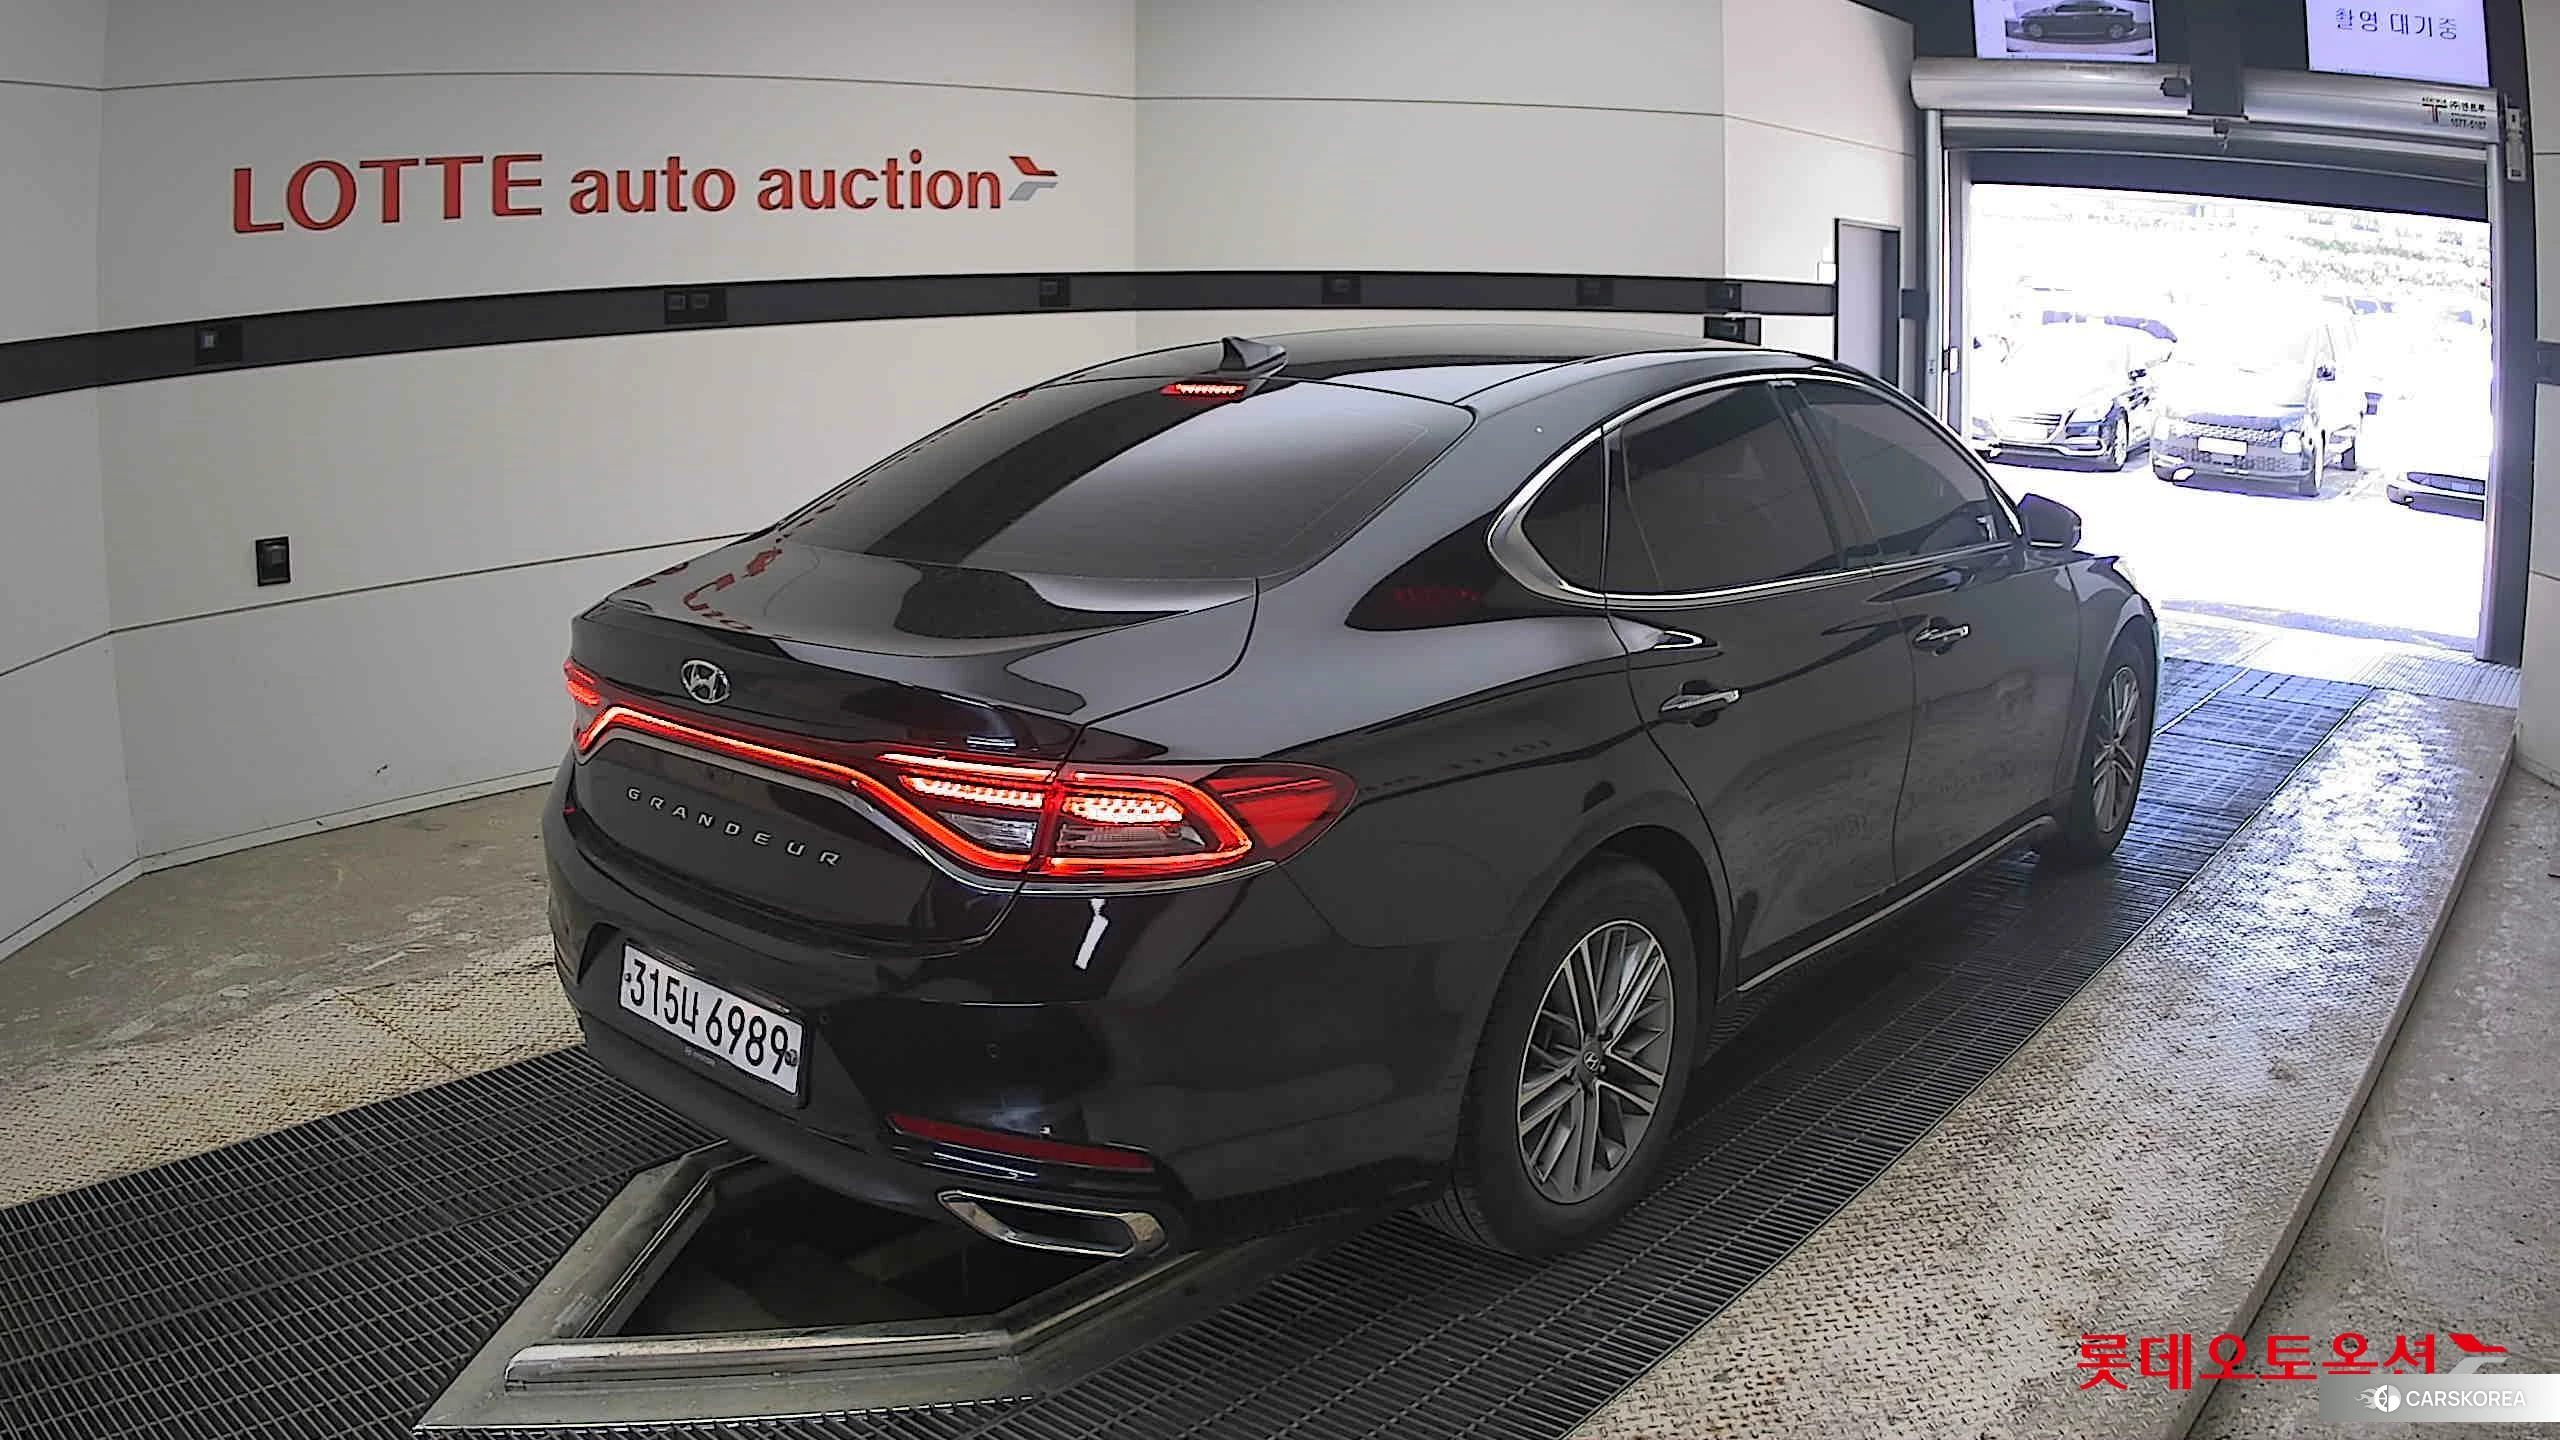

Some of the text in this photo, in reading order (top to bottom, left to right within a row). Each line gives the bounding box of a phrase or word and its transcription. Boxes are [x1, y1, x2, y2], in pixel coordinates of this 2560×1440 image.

[2336, 8, 2457, 40] 촬영 대기중
[233, 148, 1001, 234] LOTTE auto auction
[626, 786, 841, 867] GRANDEUR
[705, 997, 790, 1076] 6989
